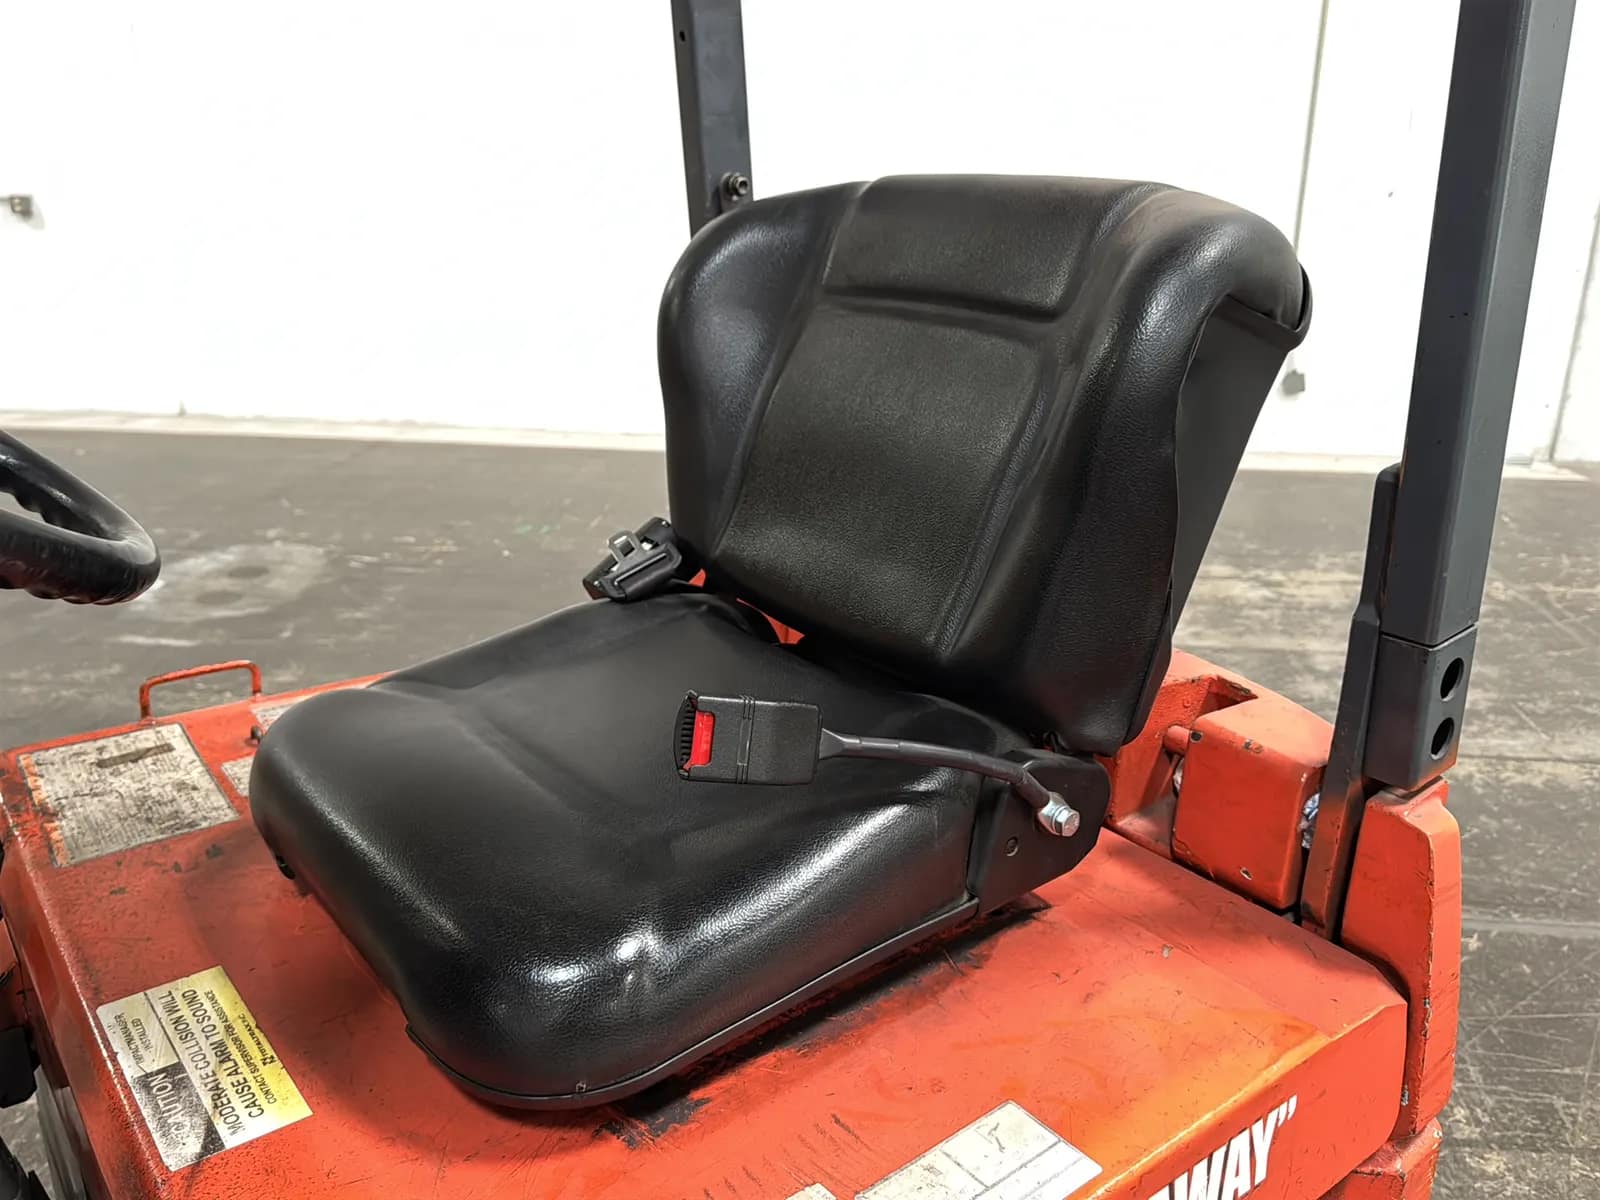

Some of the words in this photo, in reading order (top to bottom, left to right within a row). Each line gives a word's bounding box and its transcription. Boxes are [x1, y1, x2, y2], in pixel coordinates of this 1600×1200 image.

[156, 990, 181, 1015] WILL
[180, 988, 212, 1024] SOUND
[203, 989, 230, 1024] ASSISTANCE
[168, 1014, 211, 1071] COLLISION
[199, 1022, 221, 1040] TO
[223, 1022, 237, 1036] FOR
[208, 1038, 243, 1079] ALARM
[230, 1035, 260, 1074] SUPERVISOR
[146, 1071, 192, 1135] CAUTION
[198, 1069, 246, 1135] MODERATE
[230, 1077, 265, 1119] CAUSE
[252, 1073, 277, 1104] CONTACT
